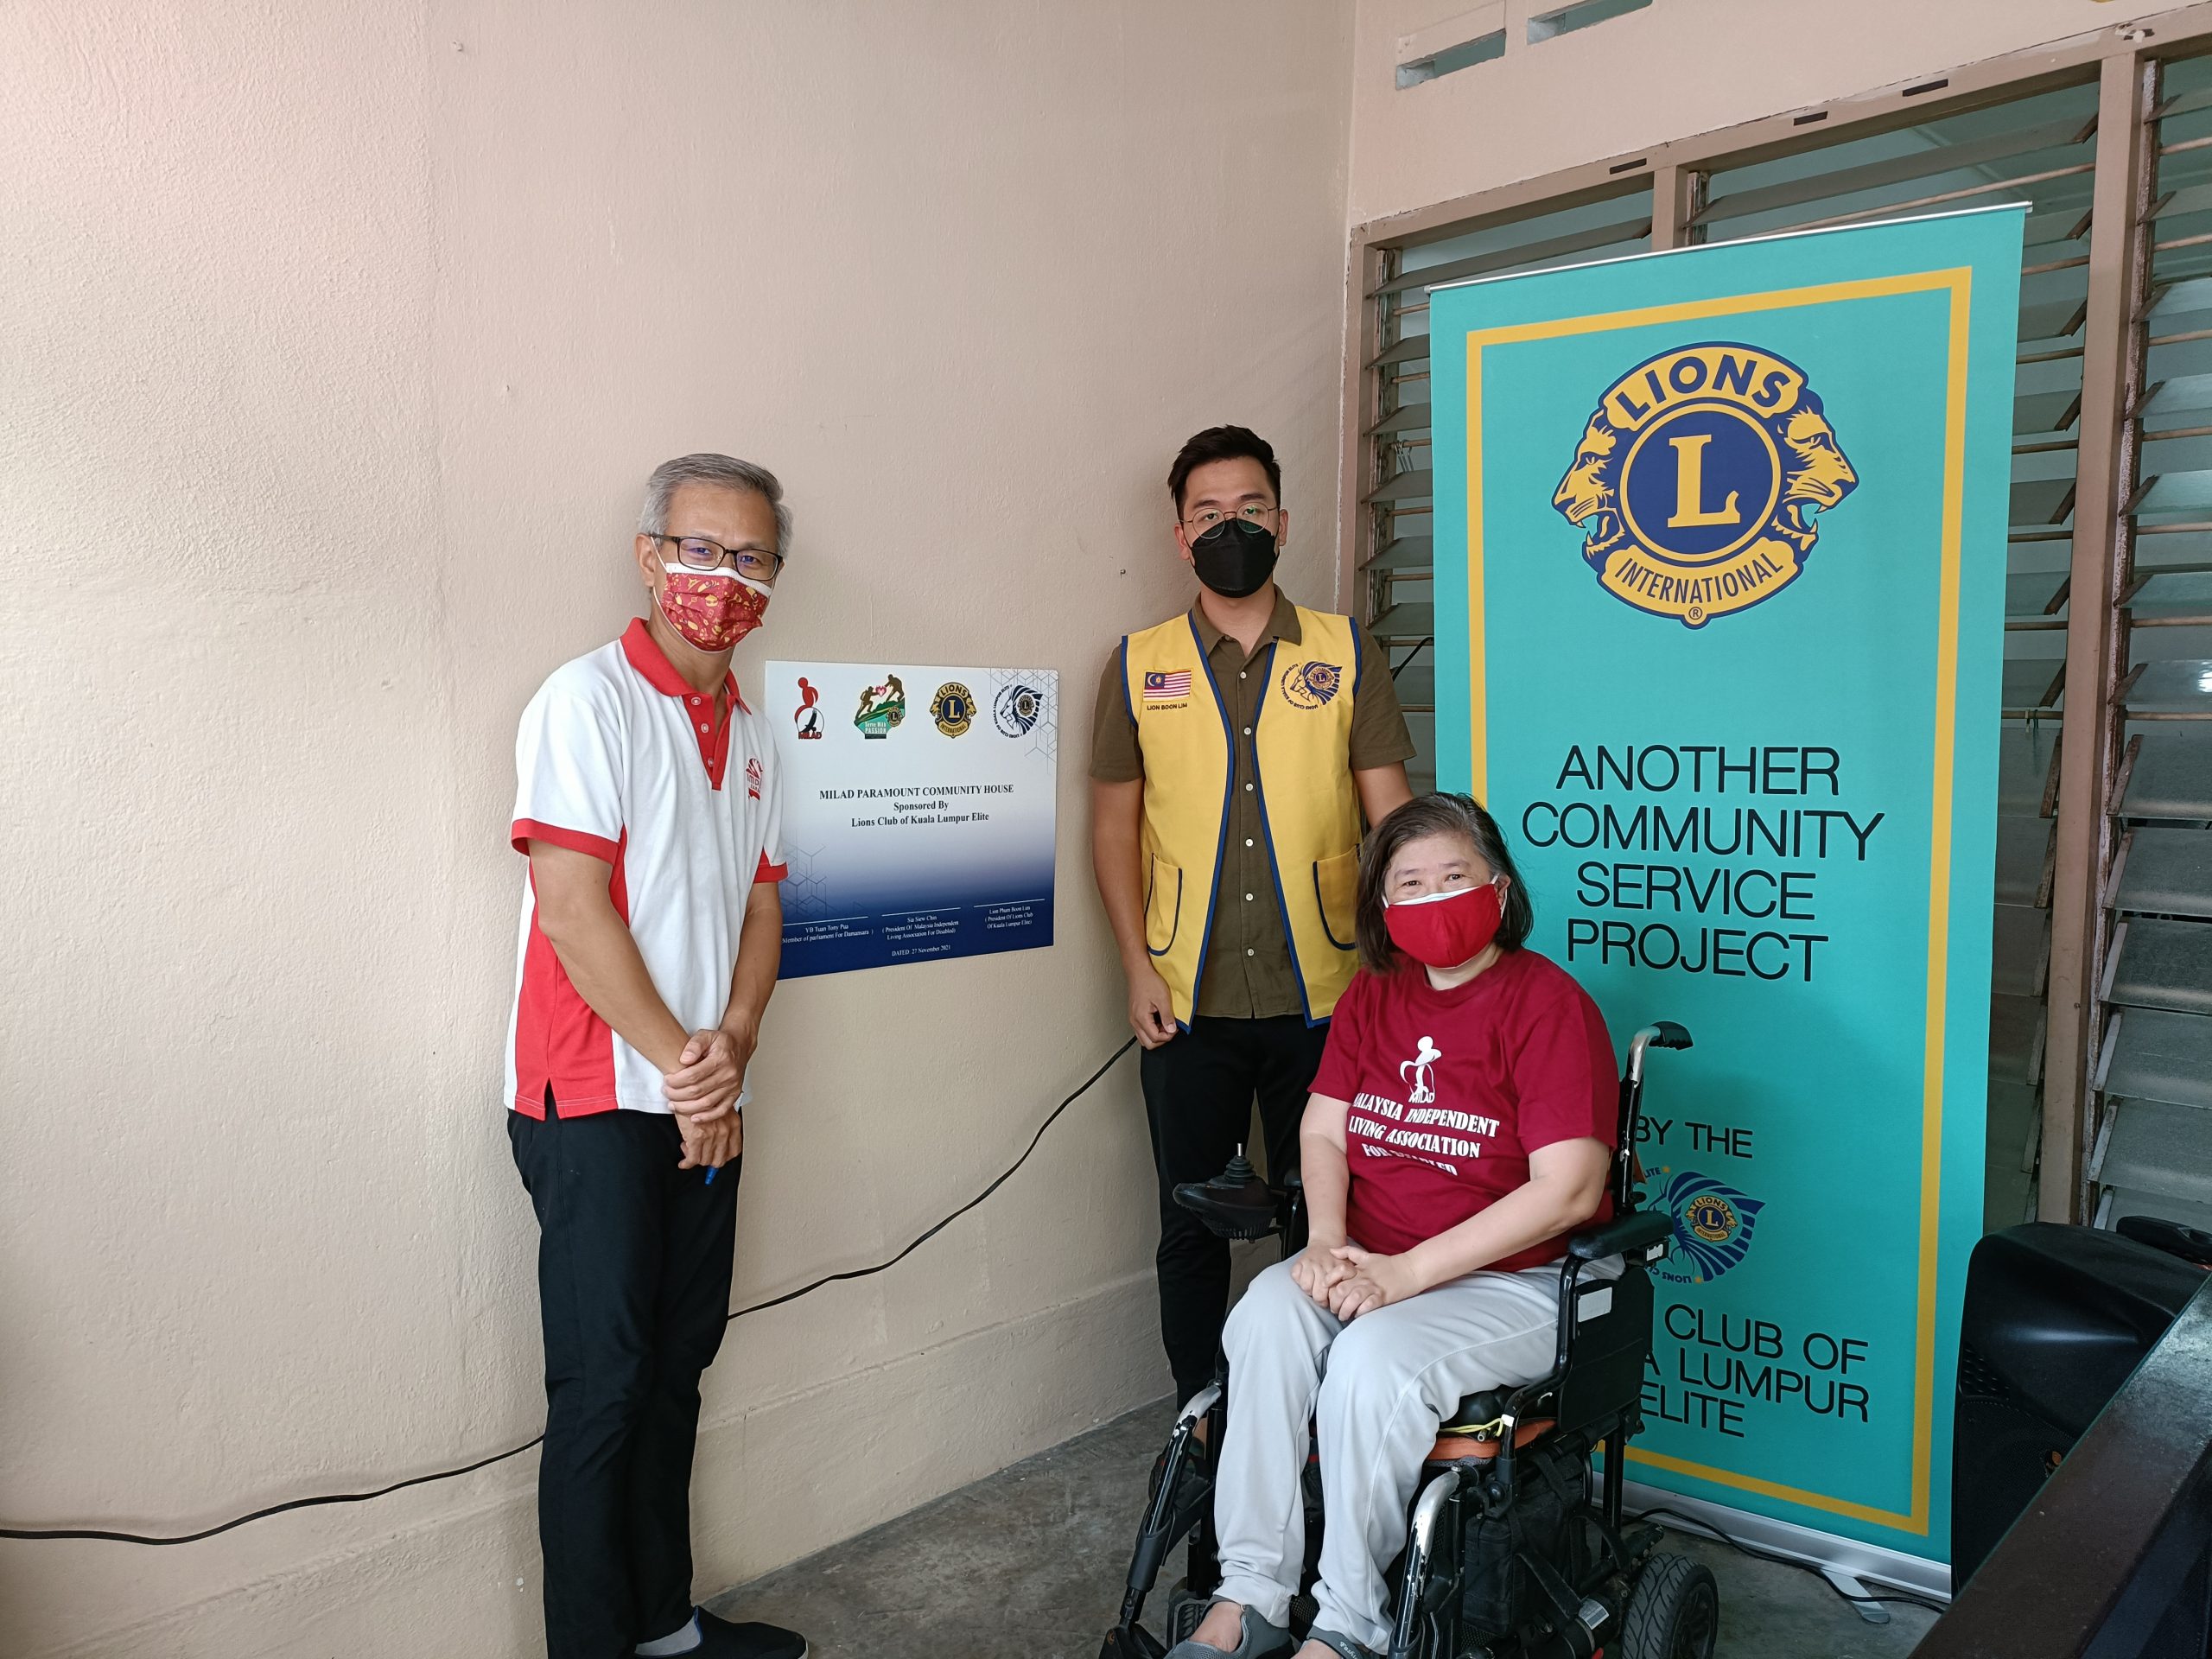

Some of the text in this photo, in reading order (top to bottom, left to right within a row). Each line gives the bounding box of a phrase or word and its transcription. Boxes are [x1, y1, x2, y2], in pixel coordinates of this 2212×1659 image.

[1615, 354, 1790, 423] LIONS
[1668, 434, 1740, 527] L
[1614, 552, 1783, 603] INTERNATIONAL
[940, 684, 967, 696] LIONS
[949, 700, 960, 718] L
[940, 722, 967, 733] INTERNATIONAL
[1556, 744, 1840, 796] ANOTHER
[819, 784, 1014, 799] MILAD PARAMOUNT COMMUNITY HOUSE
[851, 812, 989, 827] Lions Club of Kuala Lumpur Elite
[893, 800, 949, 813] Sponsored By
[1522, 801, 1885, 861] COMMUNITY
[1577, 861, 1815, 920] SERVICE
[1567, 918, 1828, 982] PROJECT
[1408, 1092, 1435, 1103] MILAD
[1348, 1116, 1481, 1158] LIVING ASSOCIATION
[1403, 1109, 1500, 1137] INDEPENDENT
[1636, 1115, 1753, 1159] BY THE
[1644, 1166, 1662, 1178] LITE
[1696, 1198, 1727, 1210] LIONS
[1706, 1210, 1719, 1227] L
[1696, 1228, 1726, 1239] INTERNATIONAL
[1662, 1271, 1692, 1283] LIONS
[1664, 1303, 1869, 1375] CLUB OF
[1680, 1347, 1870, 1423] LUMPUR
[1640, 1382, 1745, 1438] ELITE
